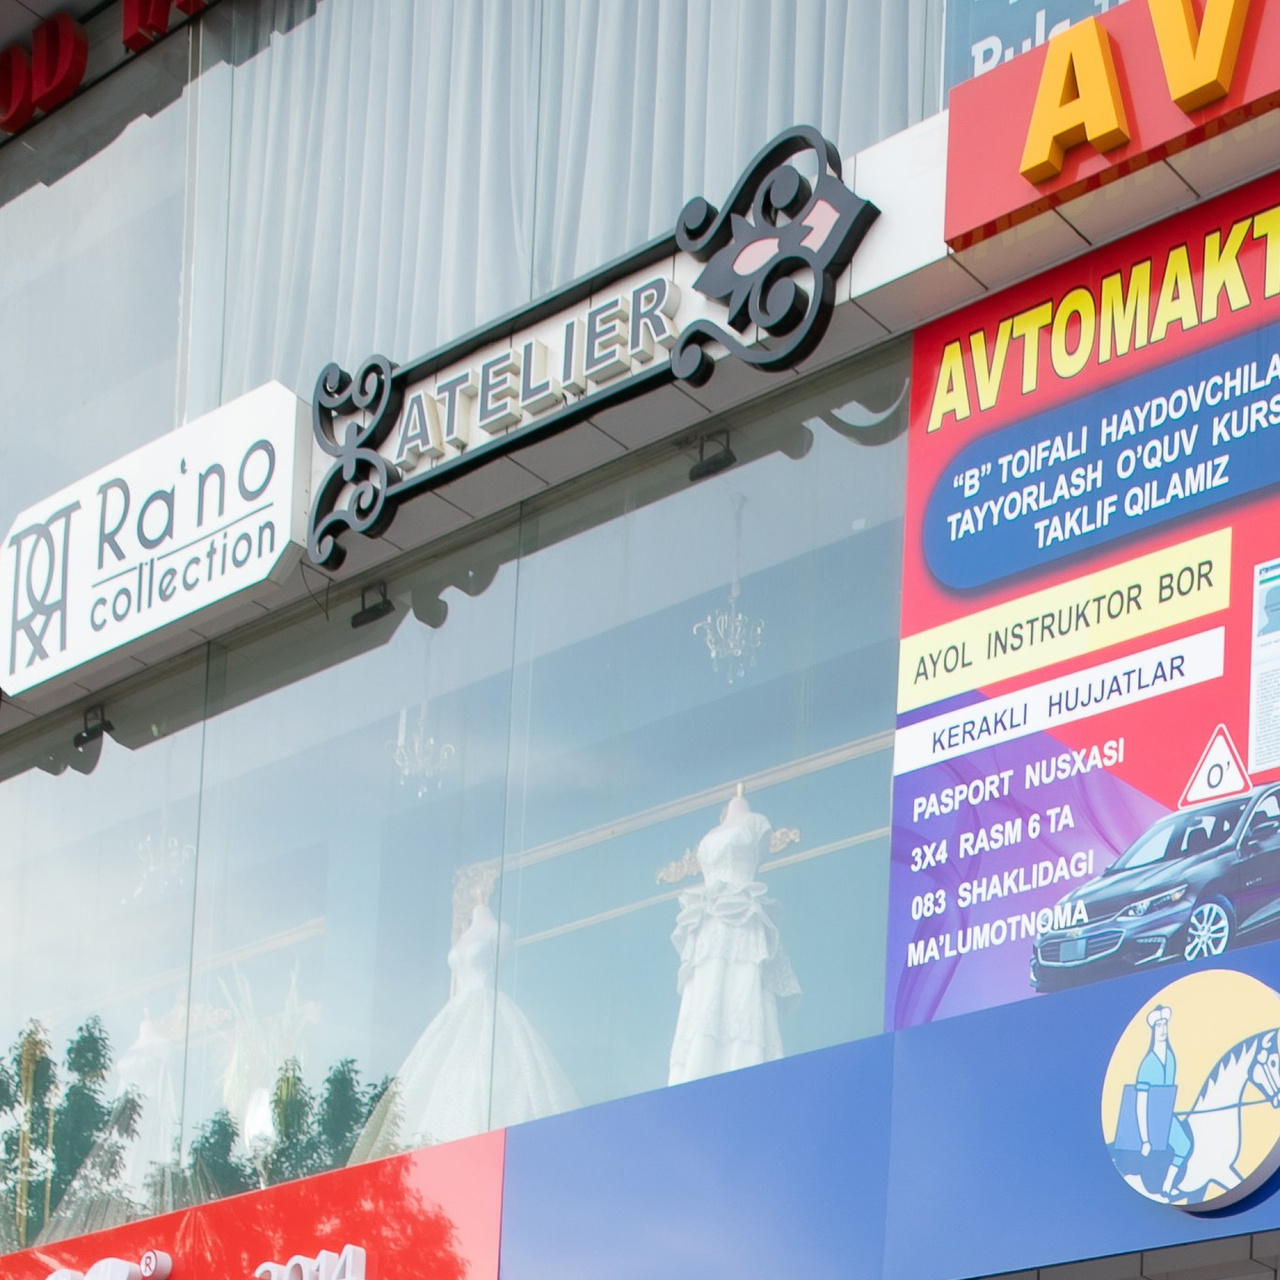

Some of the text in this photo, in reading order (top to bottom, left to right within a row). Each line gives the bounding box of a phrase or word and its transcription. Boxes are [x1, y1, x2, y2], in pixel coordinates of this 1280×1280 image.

[395, 275, 680, 470] ATELIER
[947, 456, 1104, 541] TAYYORLASH
[998, 426, 1088, 484] TOIFALI
[1034, 455, 1230, 548] TAKLIF QILAMIZ
[89, 518, 277, 631] collection
[913, 560, 1214, 684] AYOL INSTRUKTOR BOR
[932, 655, 1186, 753] KERAKLI HUJJATLAR
[913, 738, 1124, 821] PASPORT NUSXASI
[911, 806, 1075, 873] 3X4 RASM 6 TA
[911, 850, 1094, 920] 083 SHAKLIDAGI
